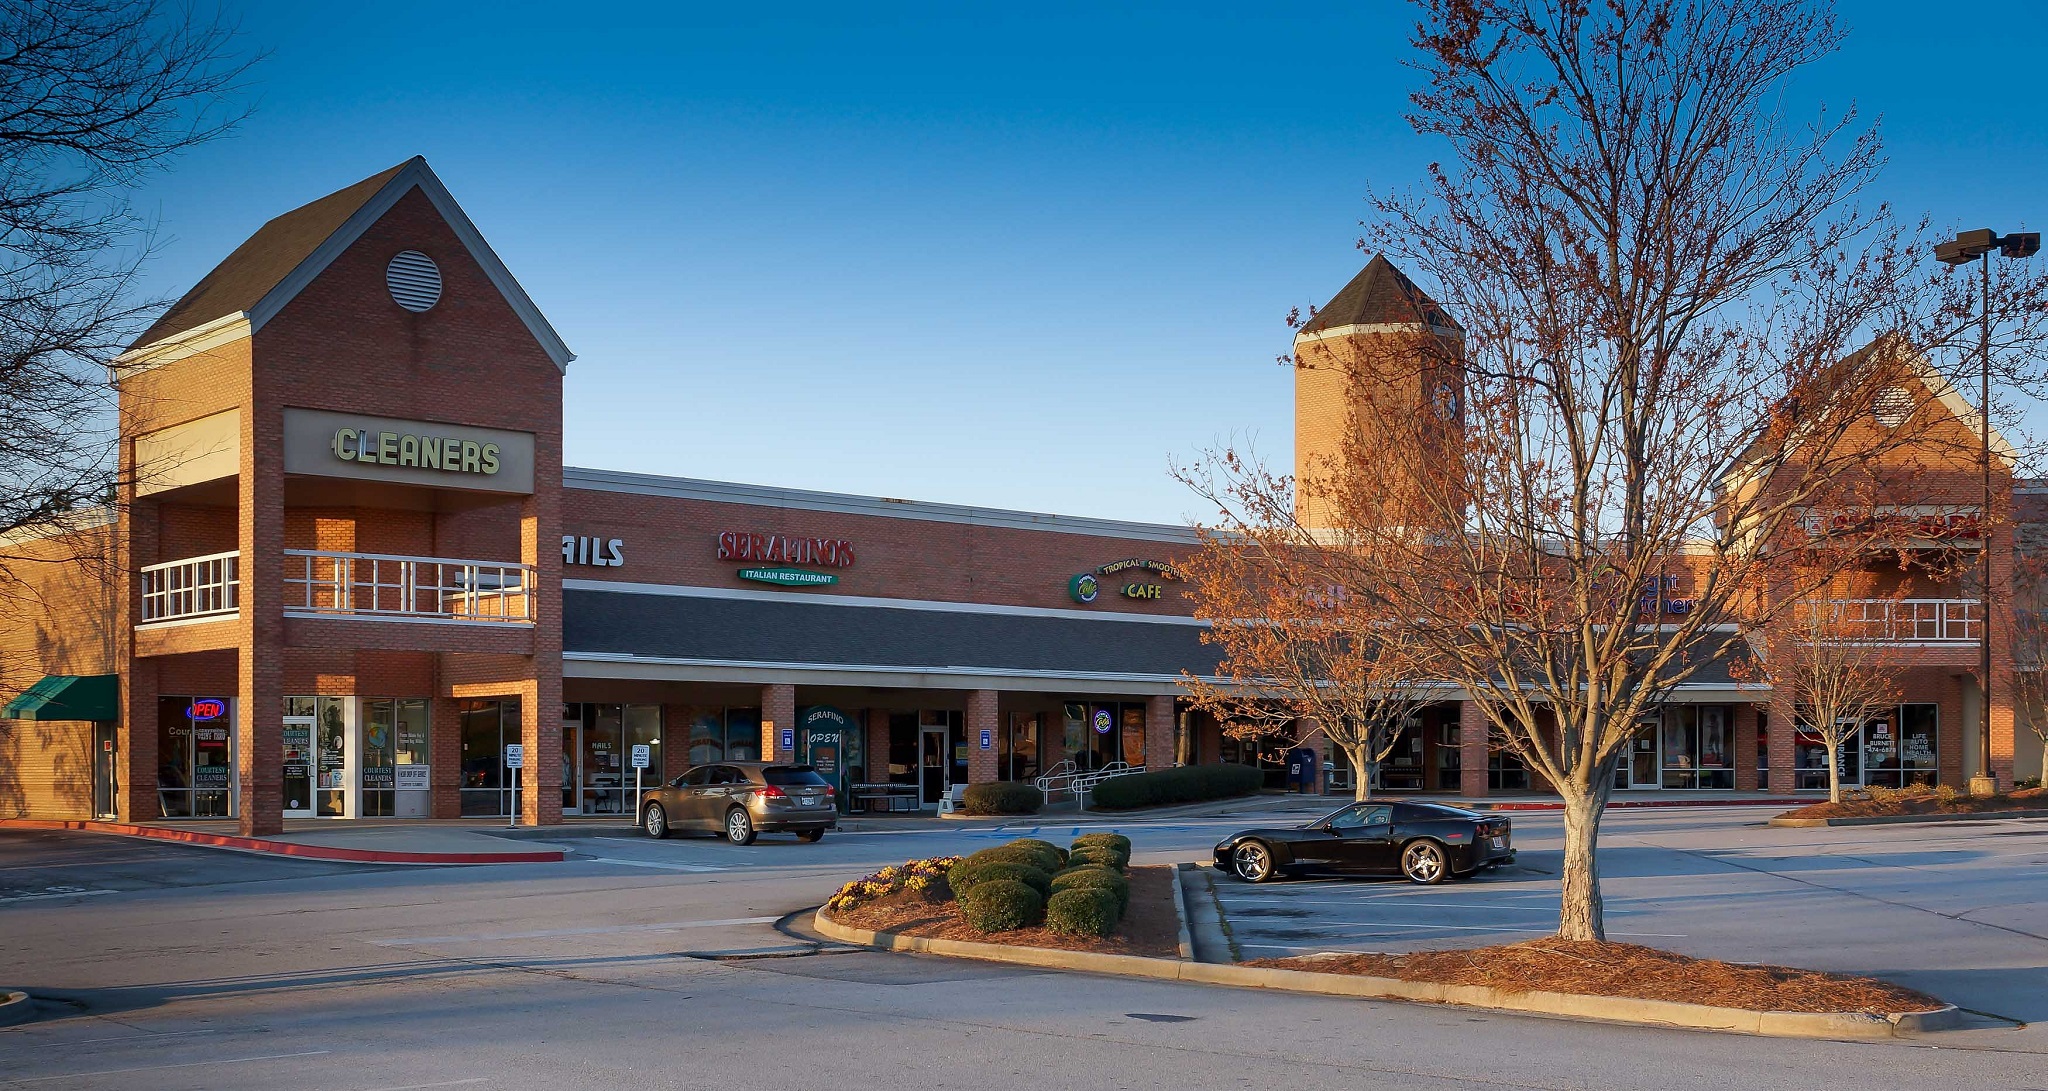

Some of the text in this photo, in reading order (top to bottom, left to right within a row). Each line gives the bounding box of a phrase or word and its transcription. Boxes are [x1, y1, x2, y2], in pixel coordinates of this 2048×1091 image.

[335, 427, 500, 475] CLEANERS
[562, 535, 623, 567] AILS
[1103, 558, 1140, 575] TROPICAL
[746, 570, 832, 583] ITALIAN RESTAURANT
[1127, 583, 1162, 599] CAFE
[807, 711, 844, 725] SERAFINO
[810, 733, 839, 743] OPEN
